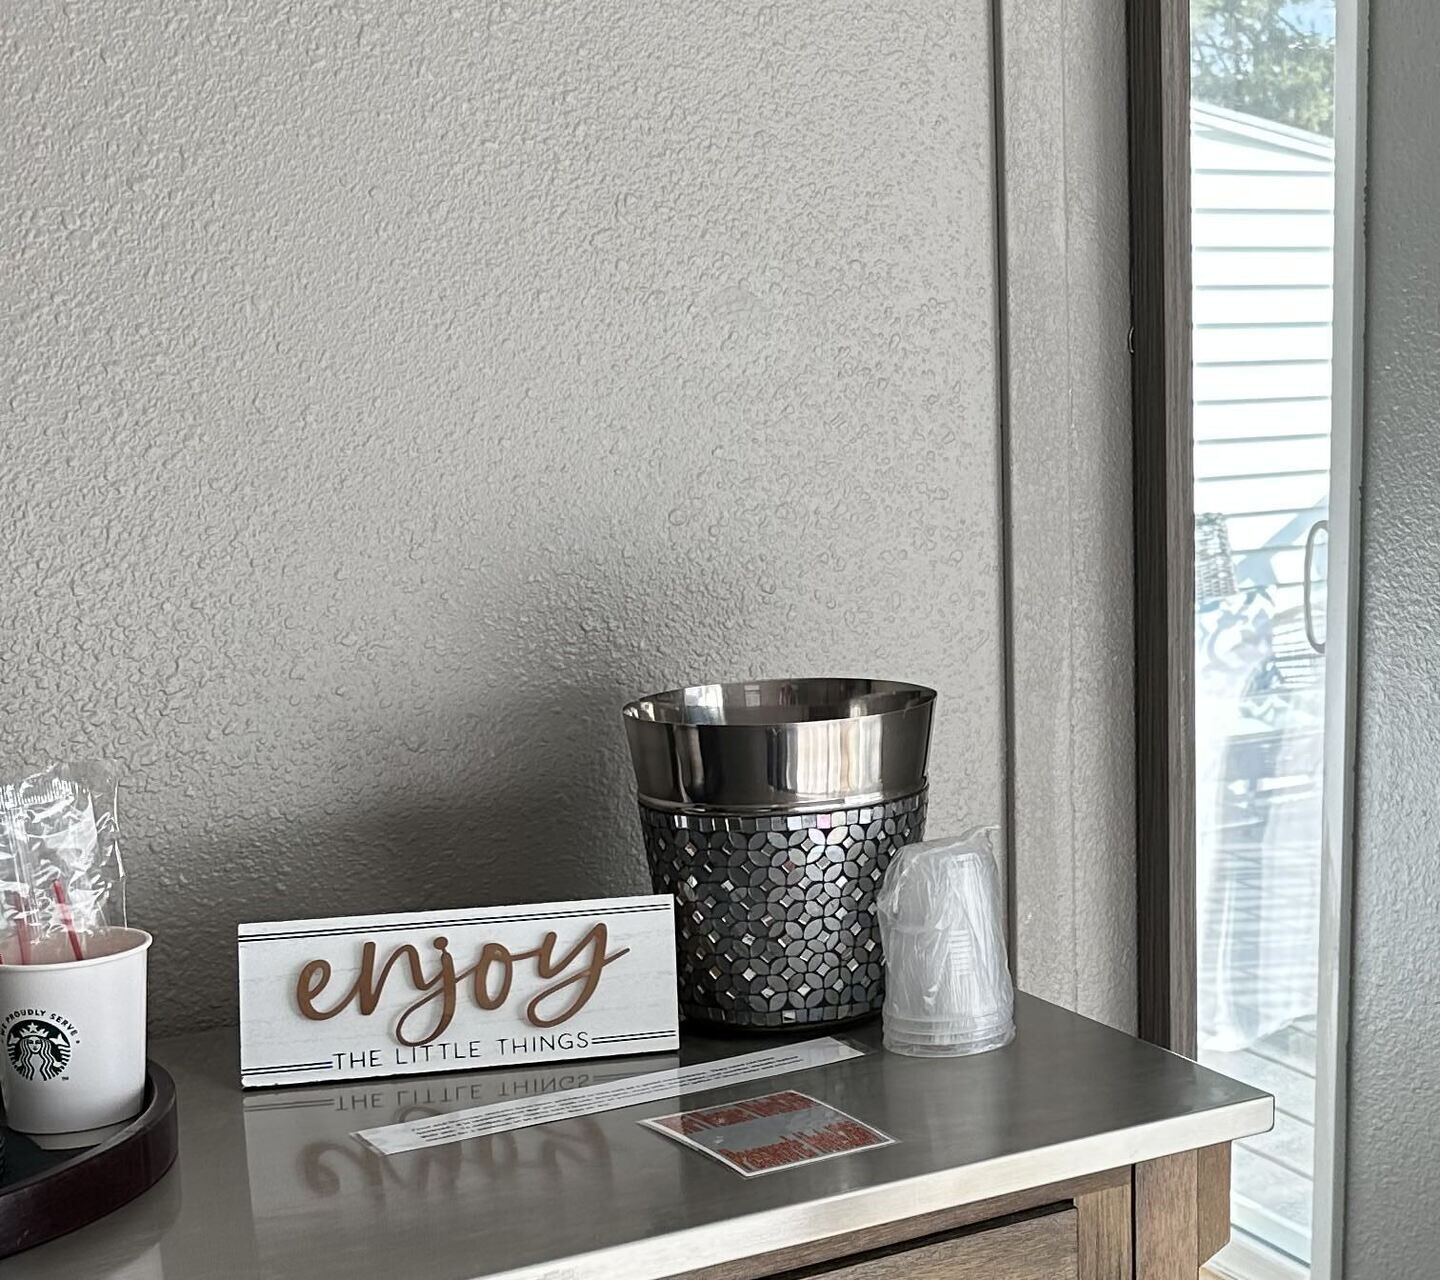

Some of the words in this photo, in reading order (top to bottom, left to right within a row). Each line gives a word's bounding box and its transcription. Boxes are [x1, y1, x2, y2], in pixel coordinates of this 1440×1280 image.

[296, 922, 631, 1049] enjoy
[5, 1008, 46, 1024] PROUDLY
[50, 1013, 78, 1037] SERVE
[332, 1049, 382, 1070] THE
[396, 1040, 481, 1065] LITTLE
[497, 1031, 589, 1055] THINGS
